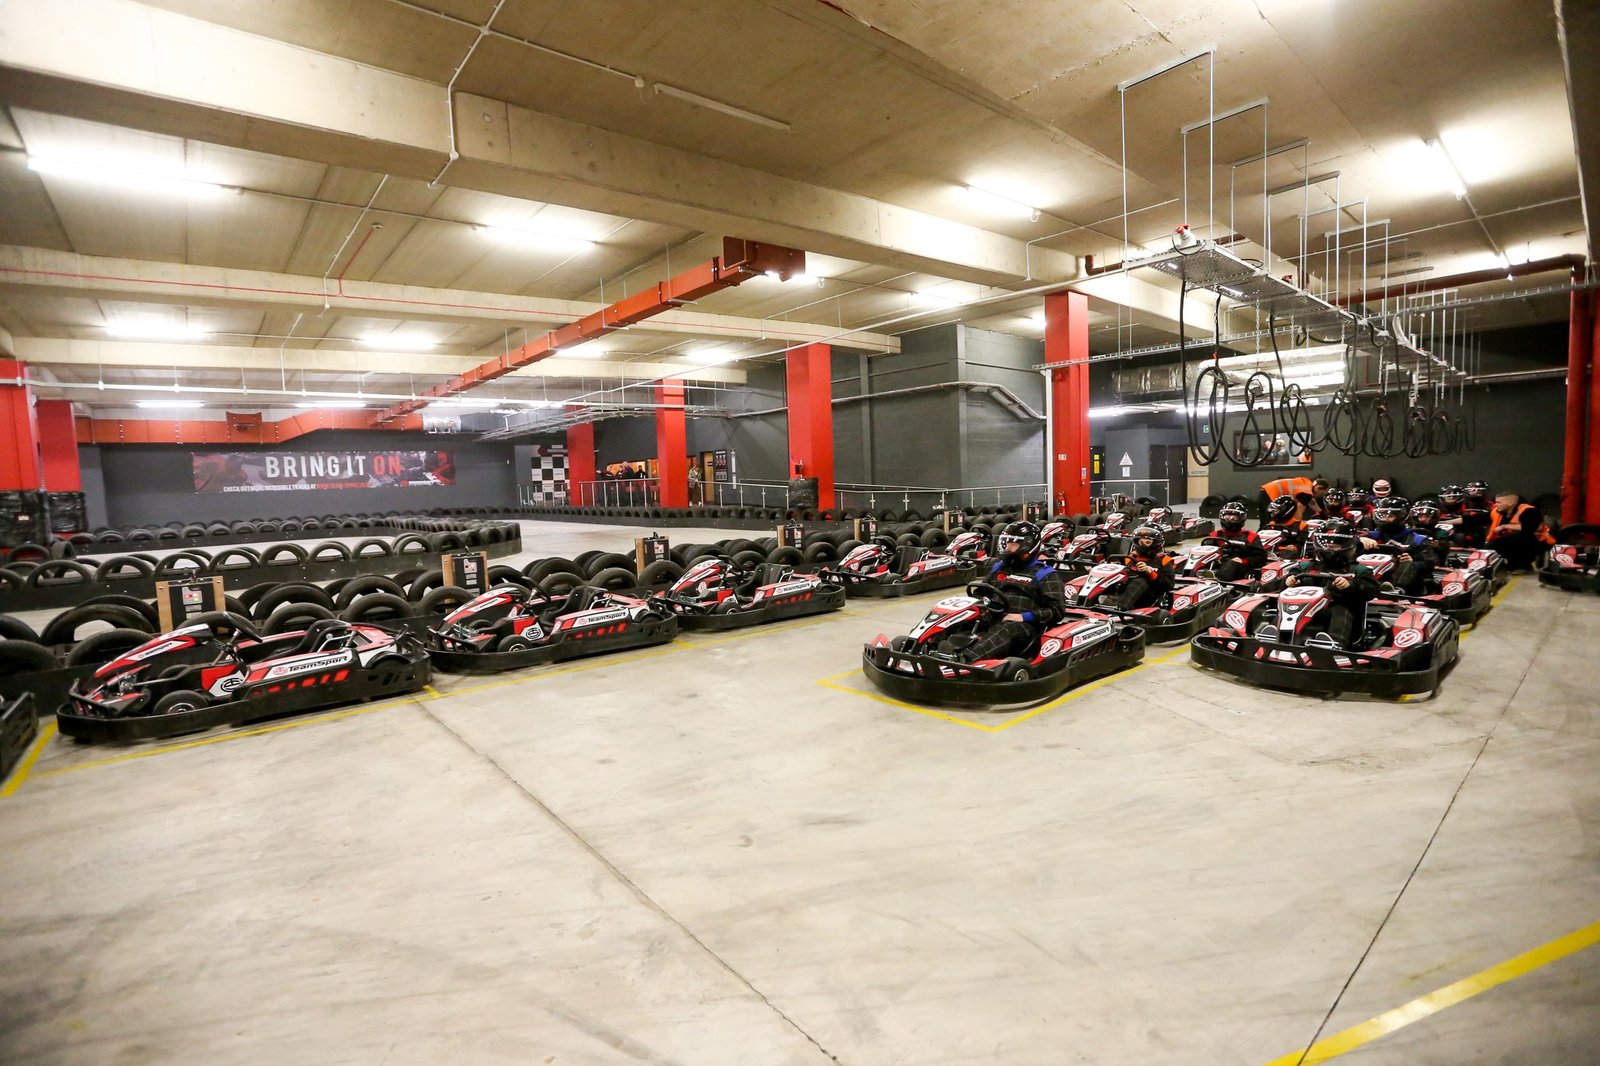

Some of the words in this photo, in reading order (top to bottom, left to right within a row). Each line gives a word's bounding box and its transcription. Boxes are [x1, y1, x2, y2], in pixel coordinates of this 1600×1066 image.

[265, 455, 340, 478] BRING
[346, 455, 366, 476] IT
[373, 454, 400, 477] ON
[1283, 588, 1319, 597] 34
[940, 598, 972, 608] 30
[588, 611, 627, 623] TeamSport
[288, 655, 348, 672] TeamSport
